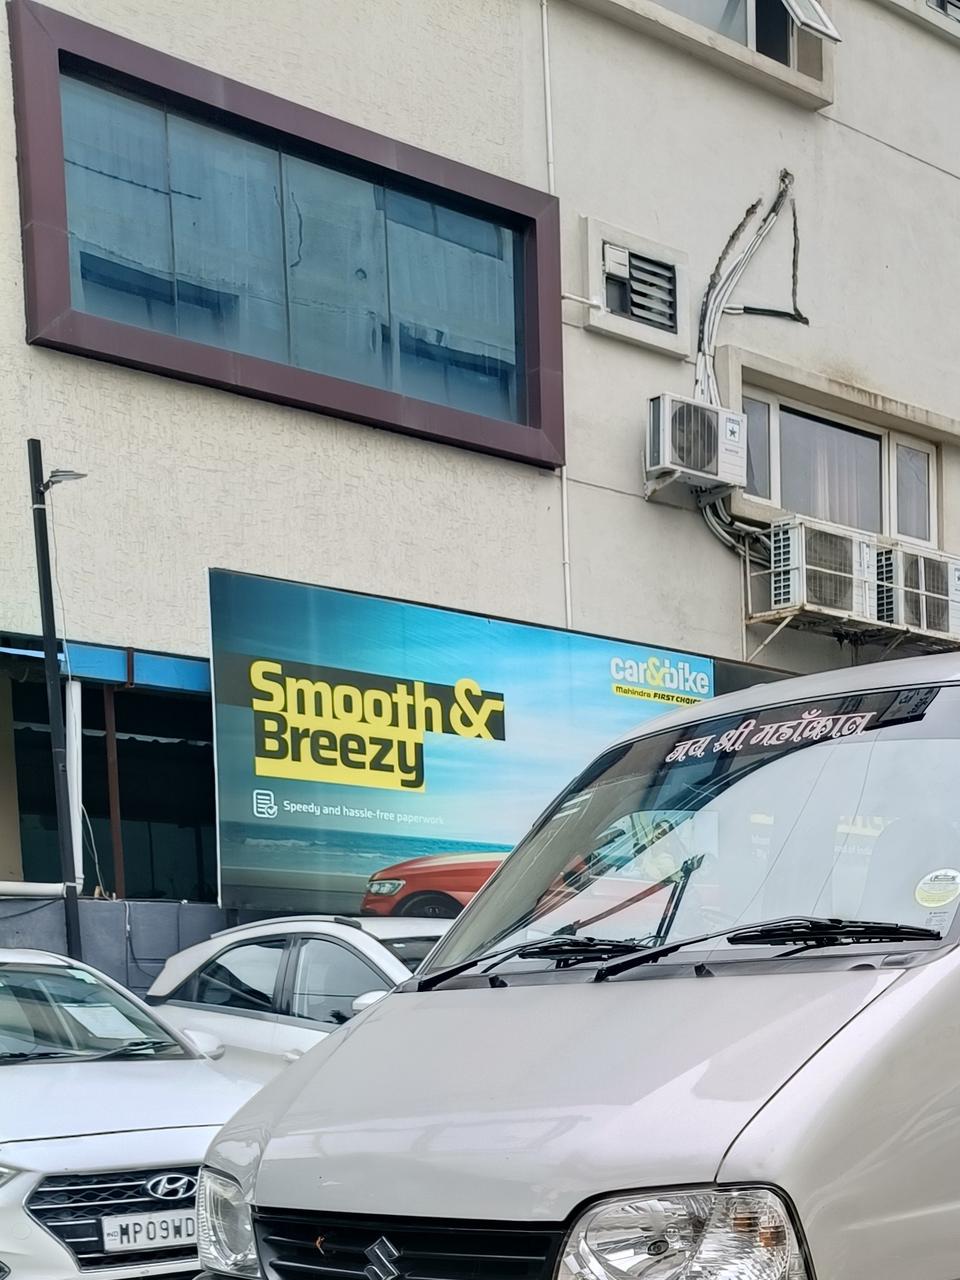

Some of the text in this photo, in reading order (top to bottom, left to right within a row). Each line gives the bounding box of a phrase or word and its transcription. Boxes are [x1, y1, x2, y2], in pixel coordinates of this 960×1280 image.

[610, 656, 709, 694] car&bike
[615, 685, 651, 698] Mahindra
[653, 692, 676, 702] FIRST
[250, 660, 504, 741] Smooth &
[254, 713, 424, 789] Breezy
[283, 800, 321, 815] Speedy
[322, 805, 342, 815] and
[342, 807, 395, 821] hassle-free
